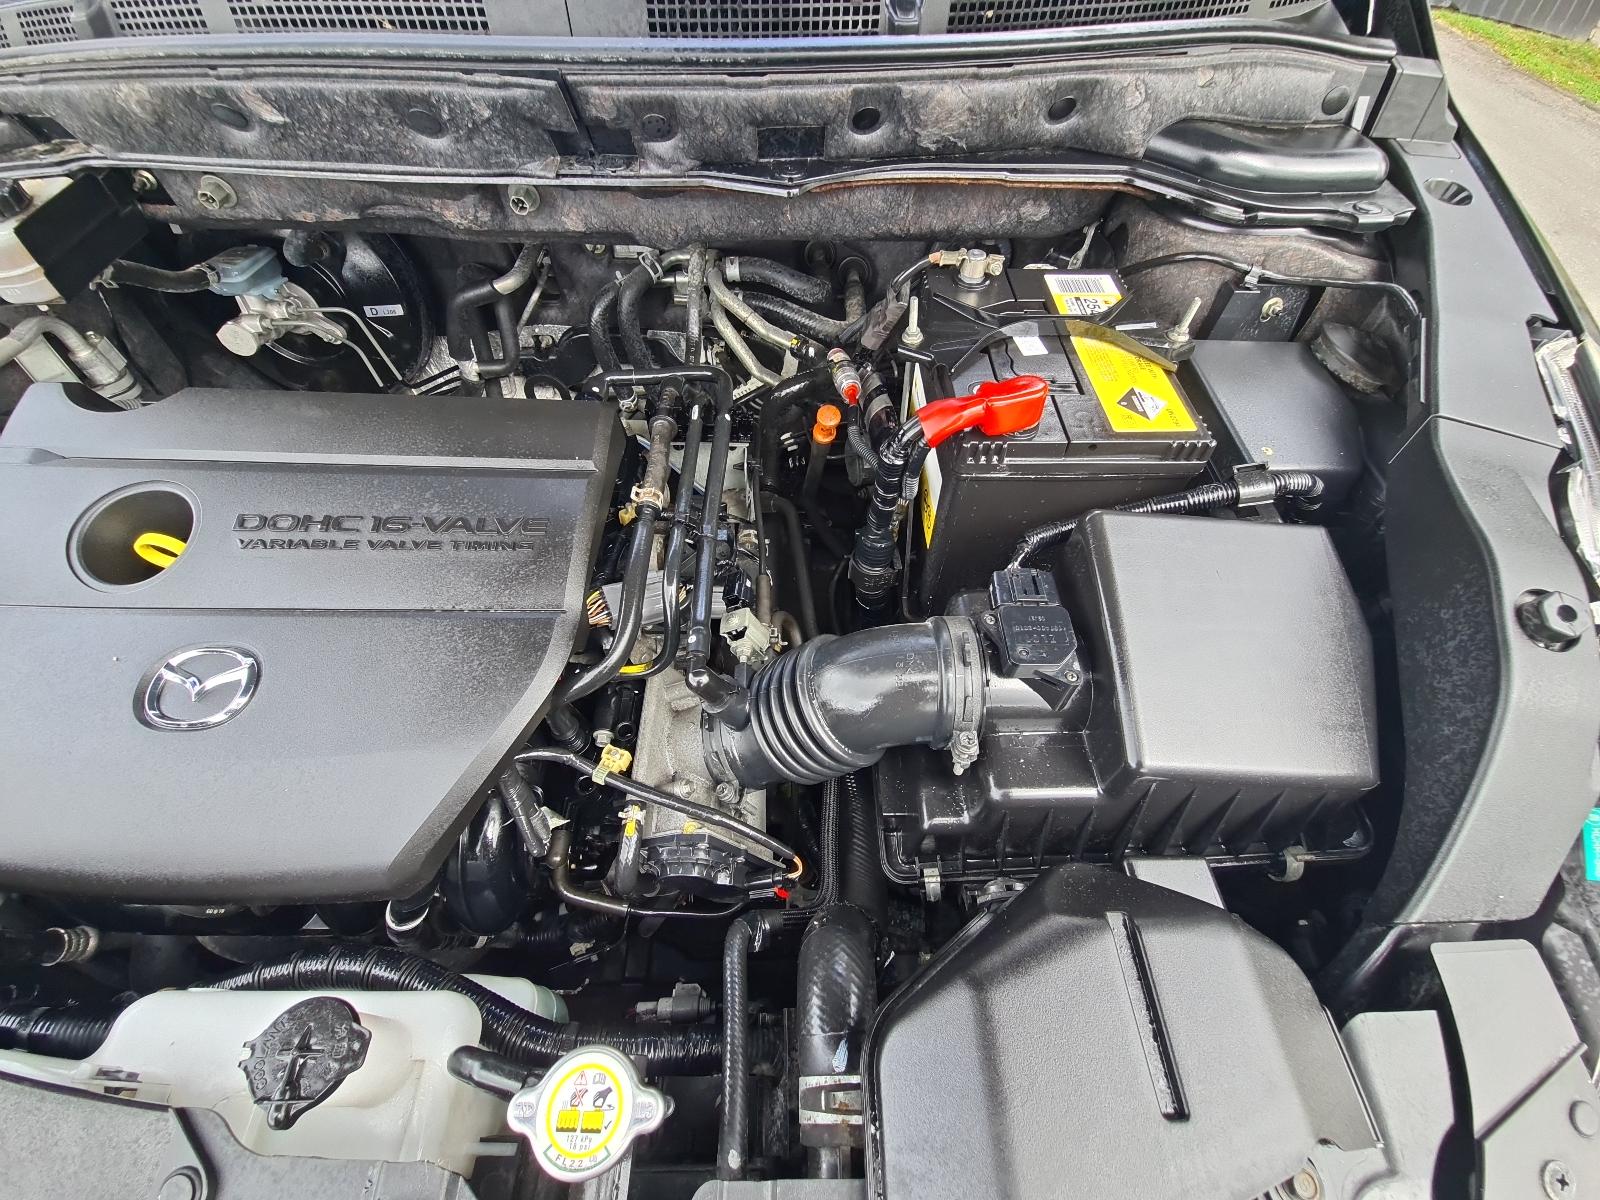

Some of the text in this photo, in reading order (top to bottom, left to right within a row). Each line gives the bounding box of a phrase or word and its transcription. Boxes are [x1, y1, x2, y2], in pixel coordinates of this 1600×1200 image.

[370, 307, 378, 316] D
[232, 513, 550, 536] DOHC 16-VALVE
[237, 538, 534, 551] VARIABLE VALVE TIMING
[253, 1013, 291, 1091] COOLANT
[555, 1153, 584, 1168] FL22
